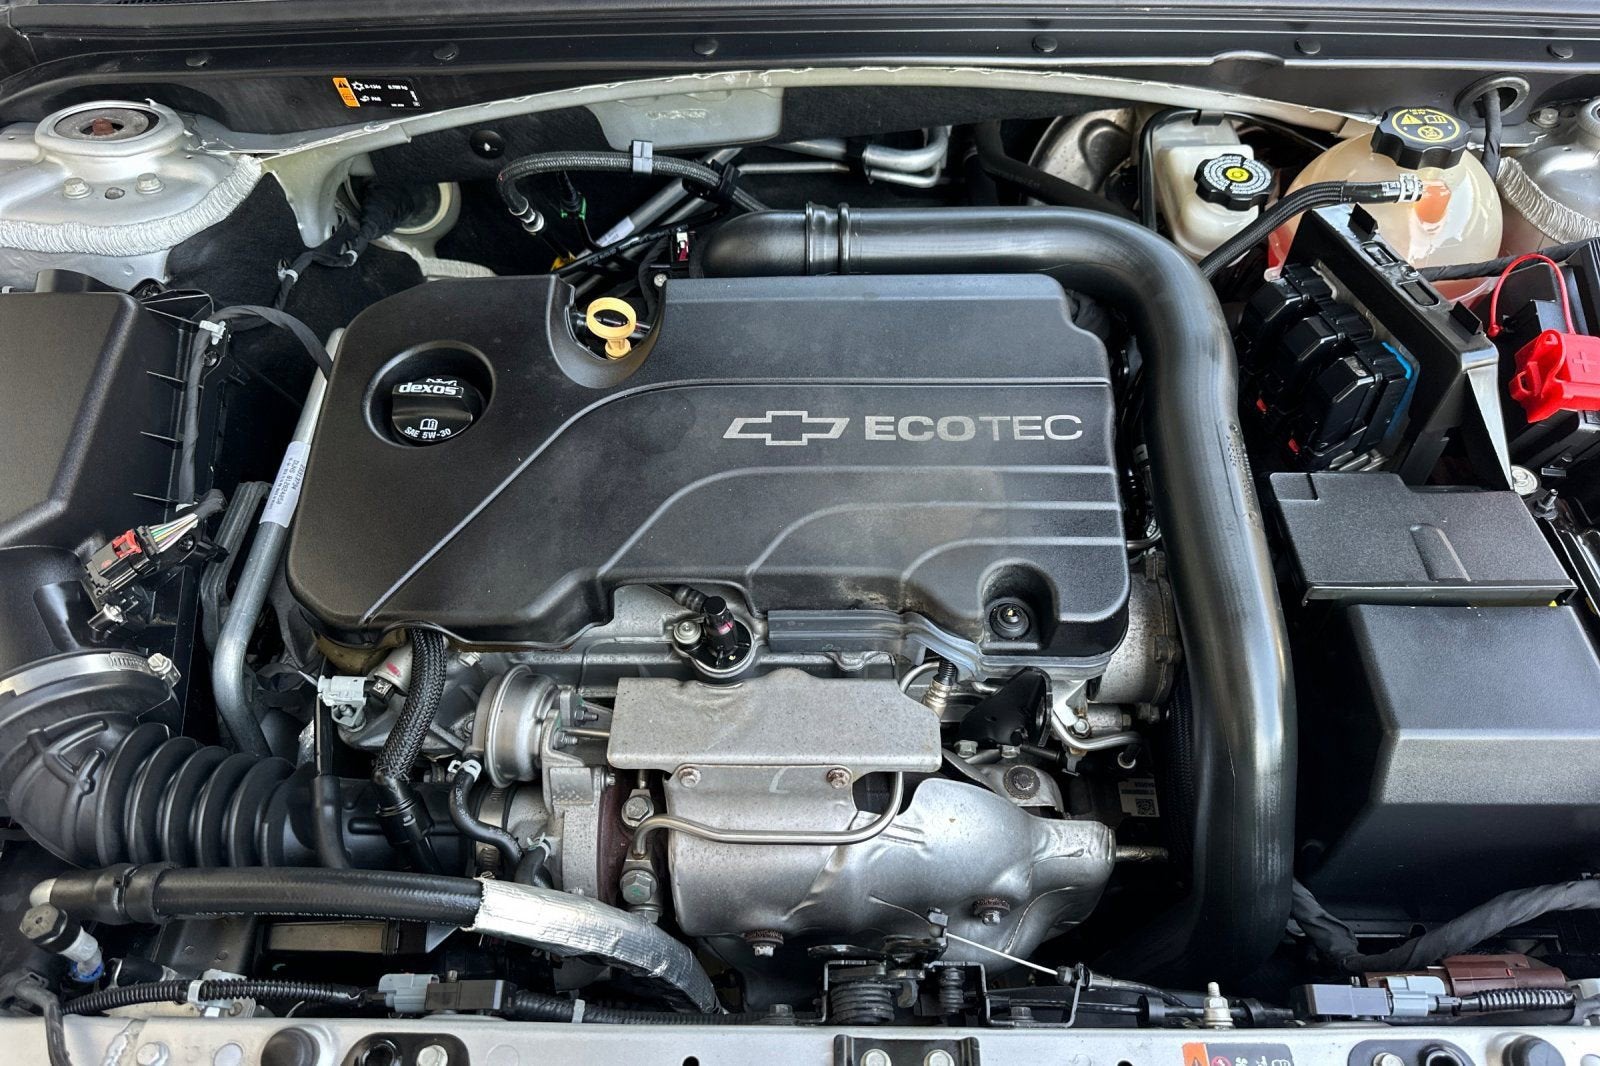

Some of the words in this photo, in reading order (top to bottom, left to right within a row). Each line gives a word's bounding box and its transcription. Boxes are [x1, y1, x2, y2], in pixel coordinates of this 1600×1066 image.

[398, 382, 460, 396] dexos
[404, 426, 421, 438] SAE
[421, 428, 452, 439] 5W-30
[864, 414, 1083, 442] ECOTEC
